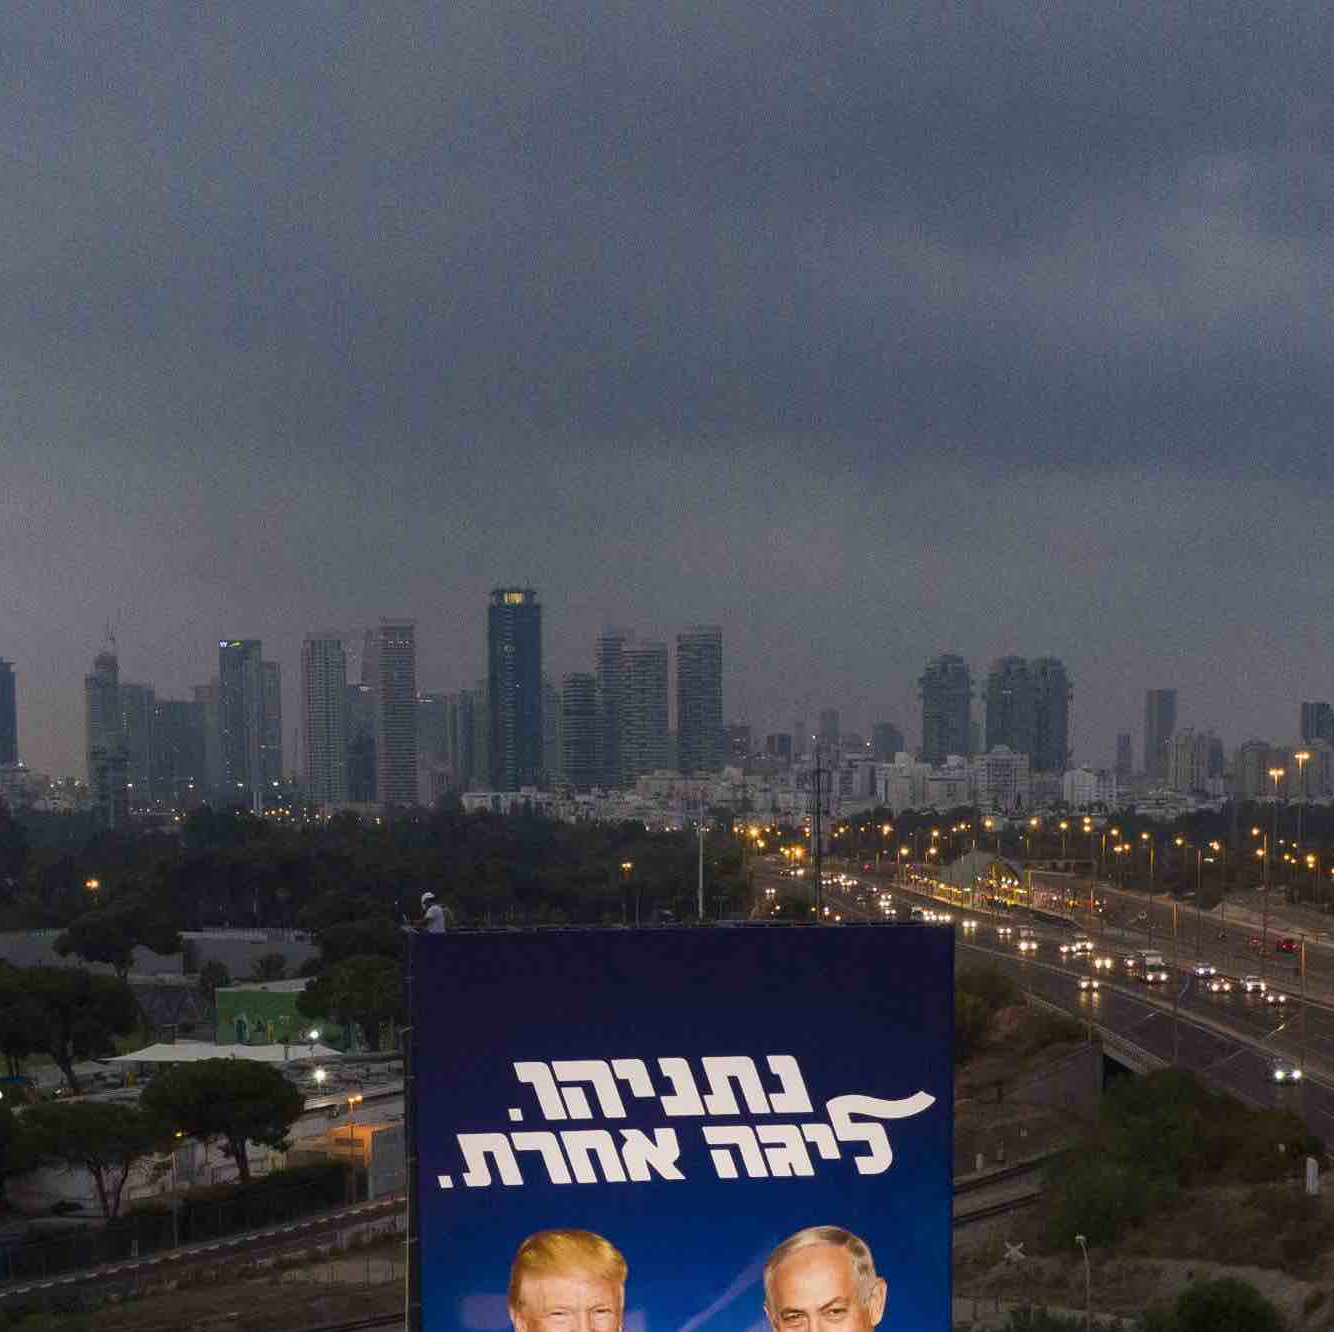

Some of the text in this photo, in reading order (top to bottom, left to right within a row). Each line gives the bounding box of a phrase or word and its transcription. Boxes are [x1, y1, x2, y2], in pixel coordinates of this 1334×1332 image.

[508, 1054, 814, 1122] נתניהו.
[437, 1090, 936, 1189] ליגה אחרת.
